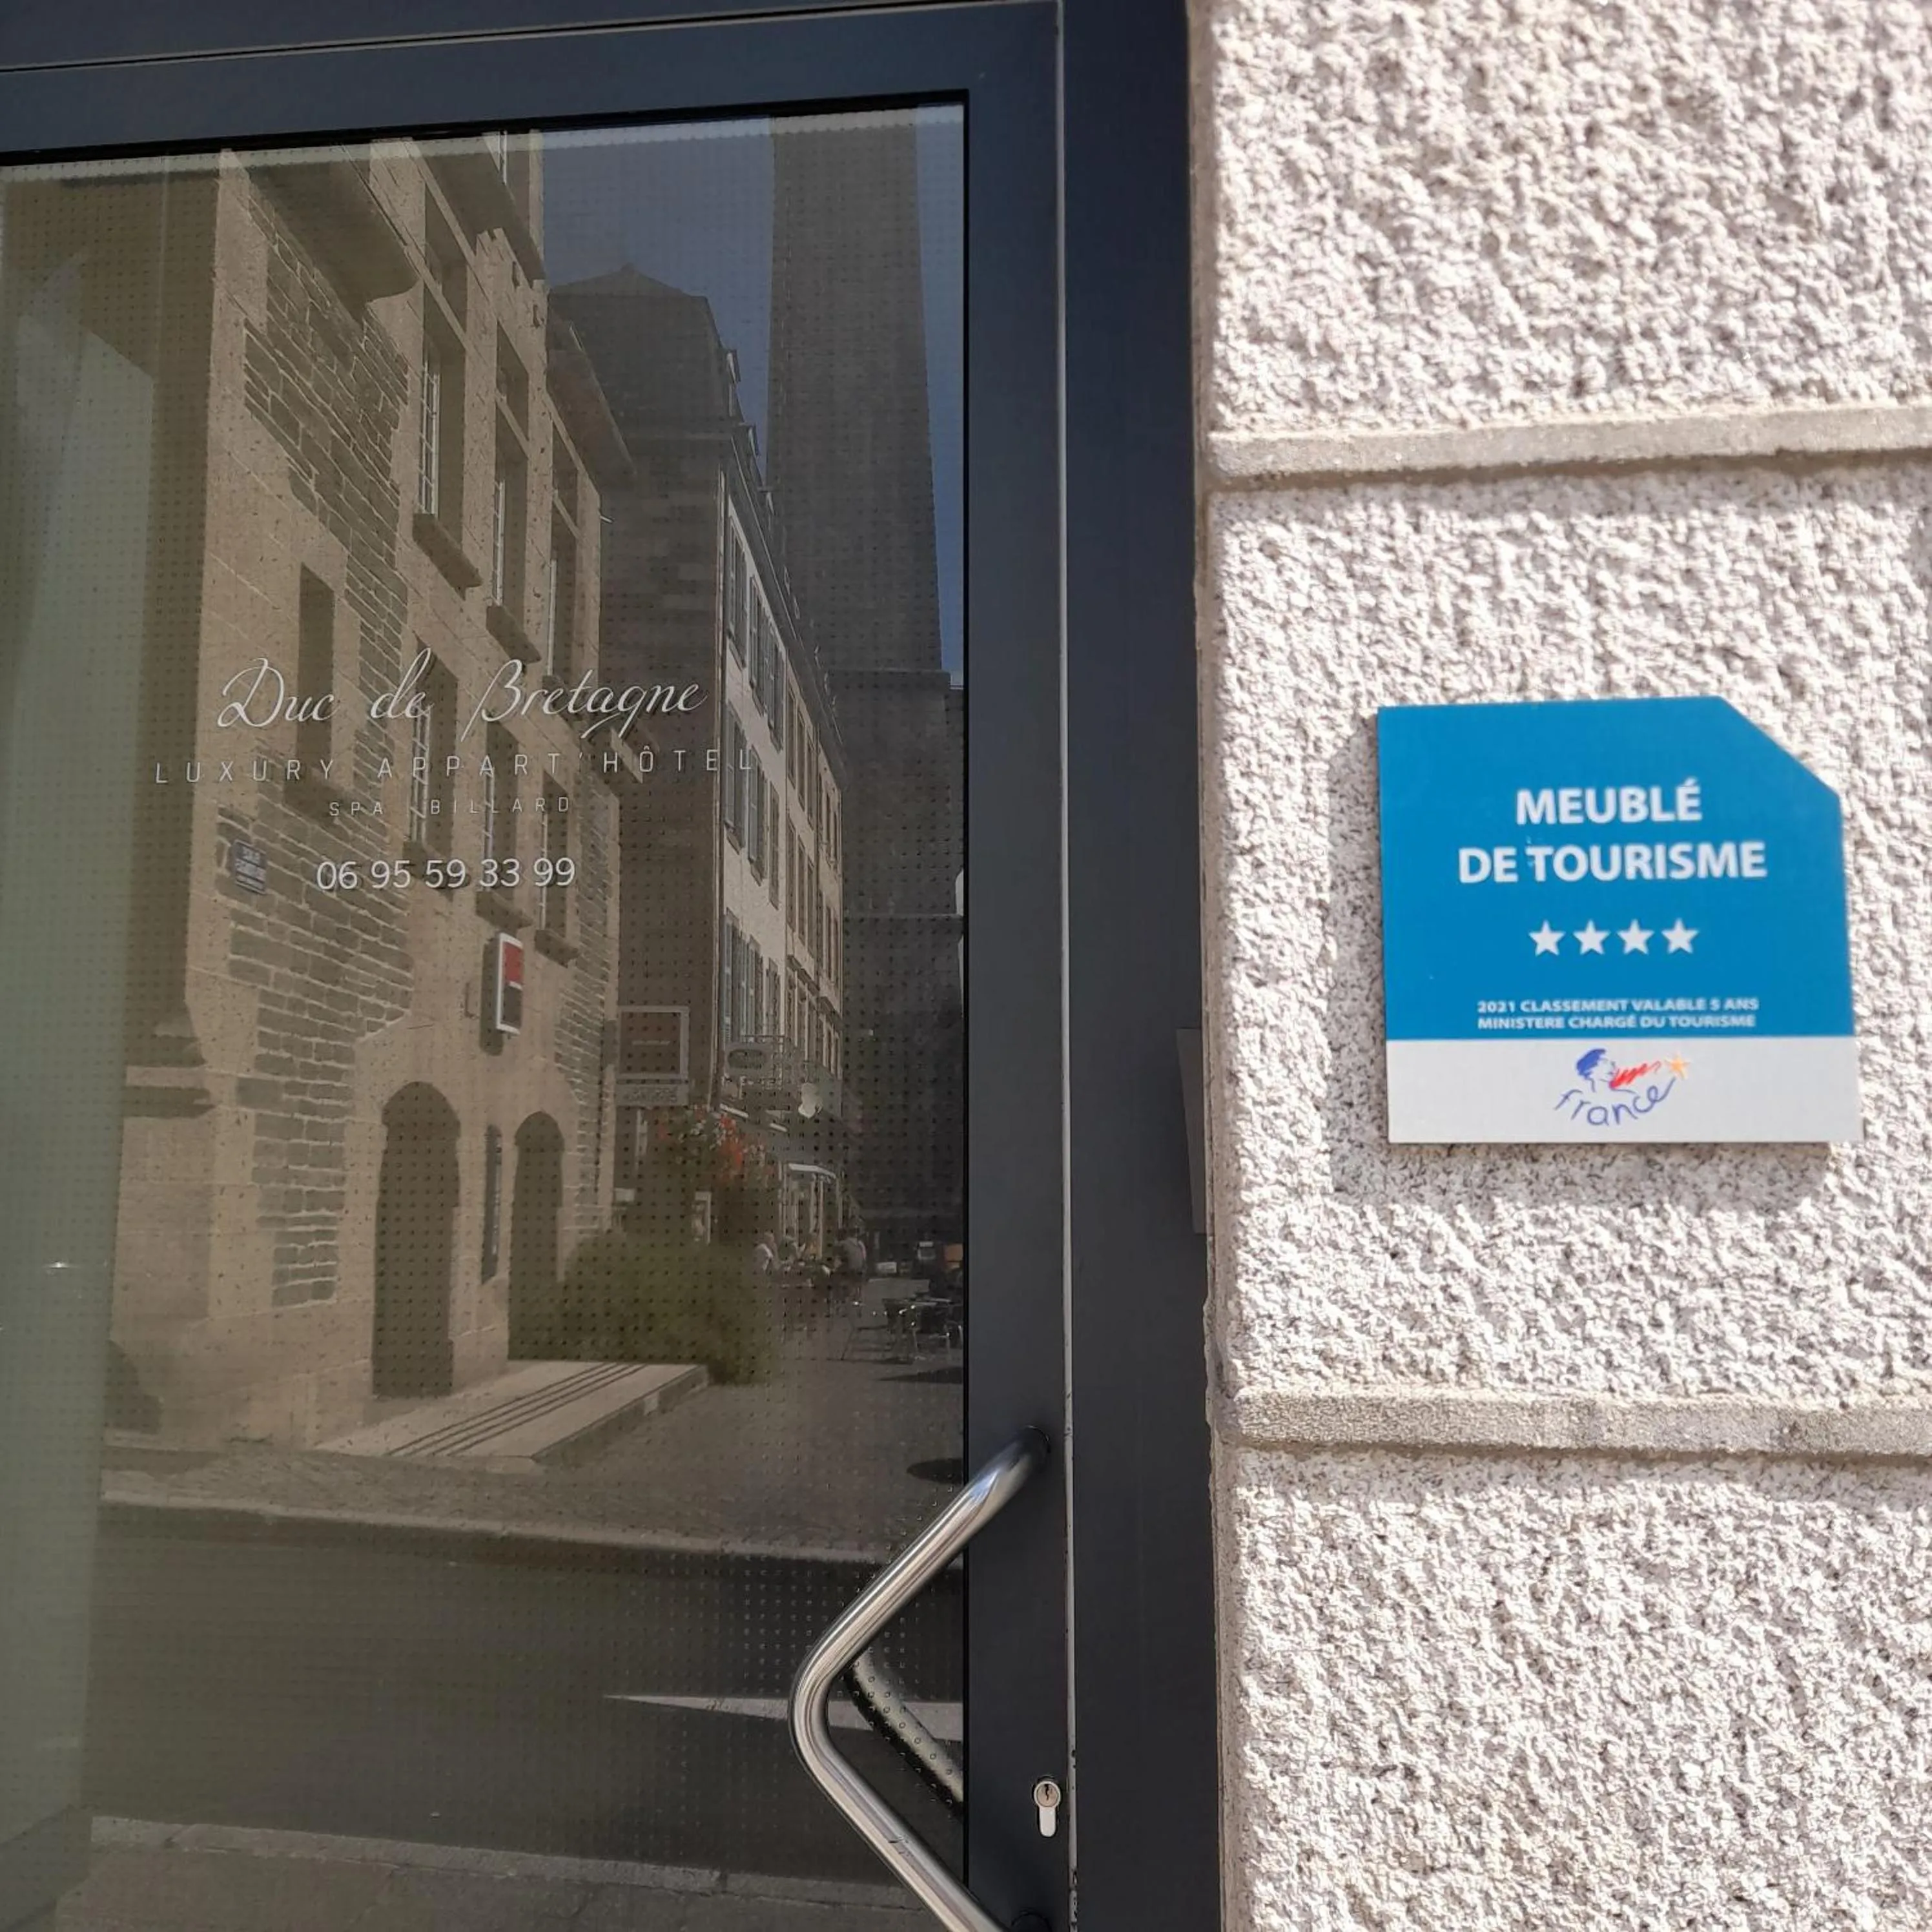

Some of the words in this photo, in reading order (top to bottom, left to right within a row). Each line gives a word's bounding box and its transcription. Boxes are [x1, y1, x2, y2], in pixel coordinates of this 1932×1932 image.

[217, 657, 340, 728] Duc
[370, 647, 435, 719] de
[460, 659, 709, 743] Bretagne
[155, 758, 334, 784] LUXURY
[328, 801, 384, 817] SPA
[430, 796, 570, 816] BILLARD
[1516, 778, 1703, 826] MEUBLÉ
[316, 861, 358, 890] 06
[371, 859, 411, 889] 95
[425, 859, 467, 889] 59
[479, 858, 521, 888] 33
[533, 857, 576, 887] 99
[1457, 847, 1518, 884] DE
[1526, 841, 1768, 883] TOURISME
[1477, 1000, 1516, 1014] 2021
[1519, 999, 1628, 1013] CLASSEMENT
[1630, 998, 1705, 1012] VALABLE
[1709, 998, 1720, 1011] 5
[1723, 998, 1760, 1011] ANS
[1568, 1013, 1638, 1029] CHARGÉ
[1643, 1015, 1666, 1028] DU
[1669, 1014, 1756, 1028] TOURISME
